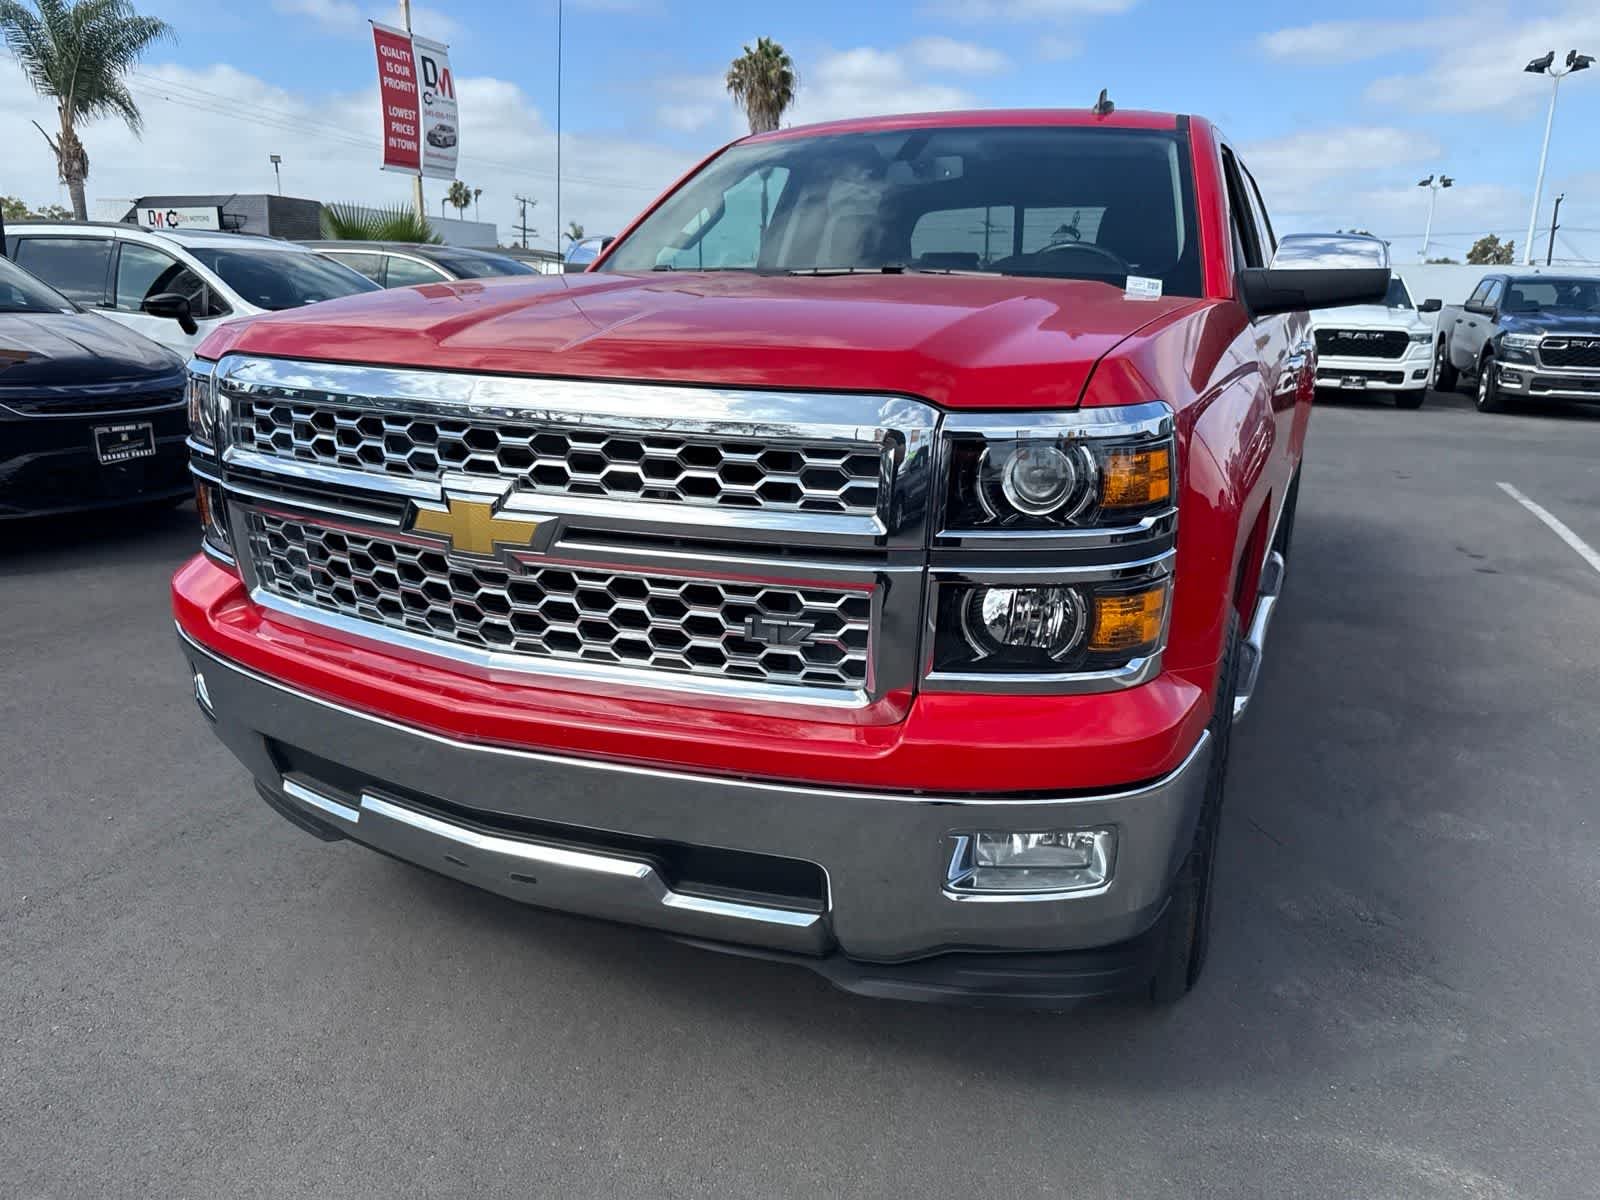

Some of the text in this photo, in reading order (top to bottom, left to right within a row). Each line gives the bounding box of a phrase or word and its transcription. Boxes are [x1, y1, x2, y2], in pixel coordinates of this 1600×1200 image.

[380, 44, 411, 63] QUALITY
[386, 61, 411, 77] IS OUR
[383, 76, 416, 94] PRIORITY
[388, 105, 416, 121] LOWEST
[391, 121, 415, 136] PRICES
[388, 136, 418, 153] IN TOWN
[1337, 331, 1385, 340] RAM
[744, 615, 816, 648] LTZ
